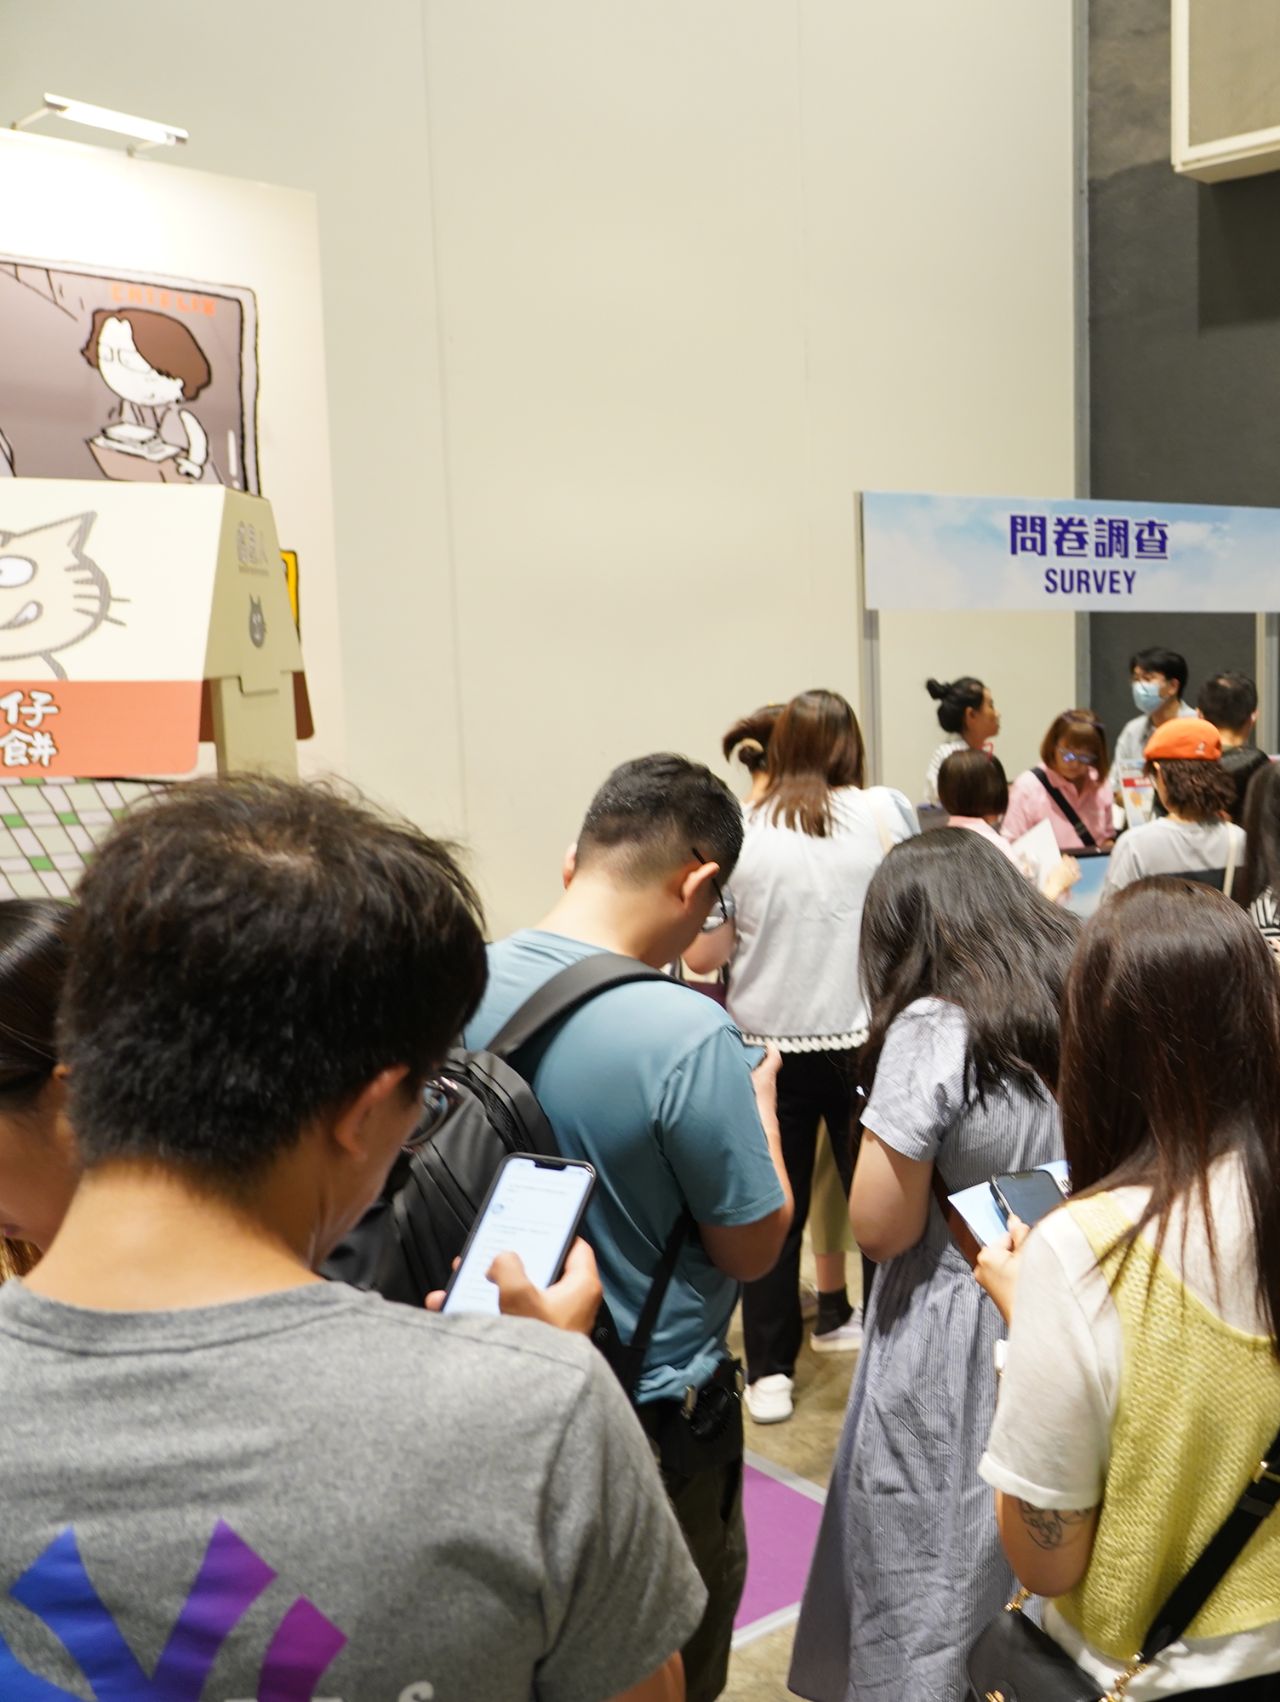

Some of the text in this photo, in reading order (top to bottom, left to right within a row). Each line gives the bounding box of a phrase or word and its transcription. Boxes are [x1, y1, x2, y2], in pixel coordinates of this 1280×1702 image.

[1010, 515, 1169, 560] 問卷調查
[1044, 567, 1137, 595] SURVEY
